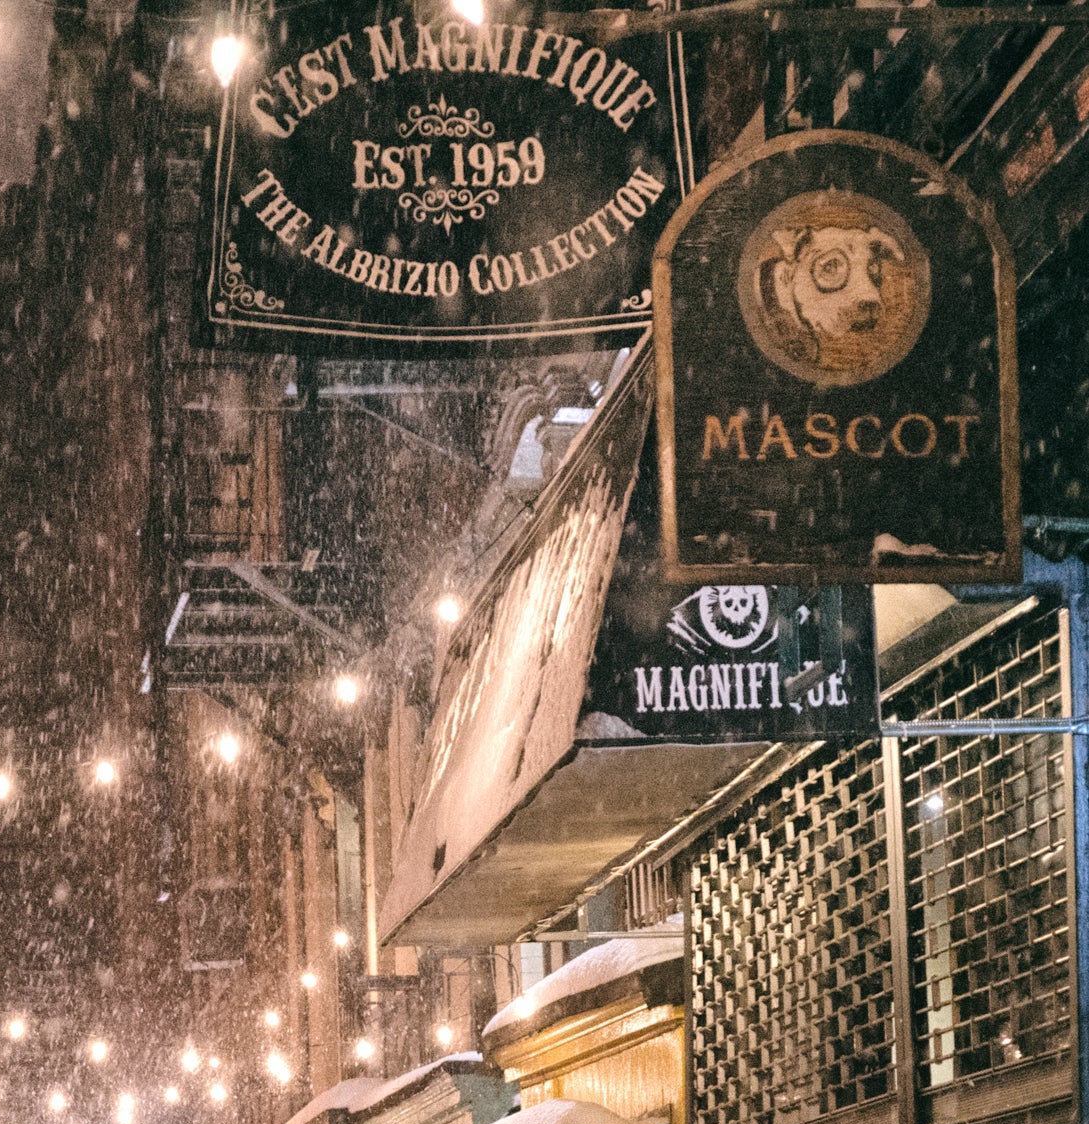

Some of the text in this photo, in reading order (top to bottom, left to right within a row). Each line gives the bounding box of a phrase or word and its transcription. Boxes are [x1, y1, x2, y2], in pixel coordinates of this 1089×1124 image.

[249, 16, 657, 139] C'EST MAGNIFIQUE
[352, 136, 546, 190] EST. 1959
[240, 165, 667, 298] THE ALBRIZIO COLLECTION
[702, 413, 980, 460] MASCOT
[633, 659, 849, 714] MAGNIFIUE
